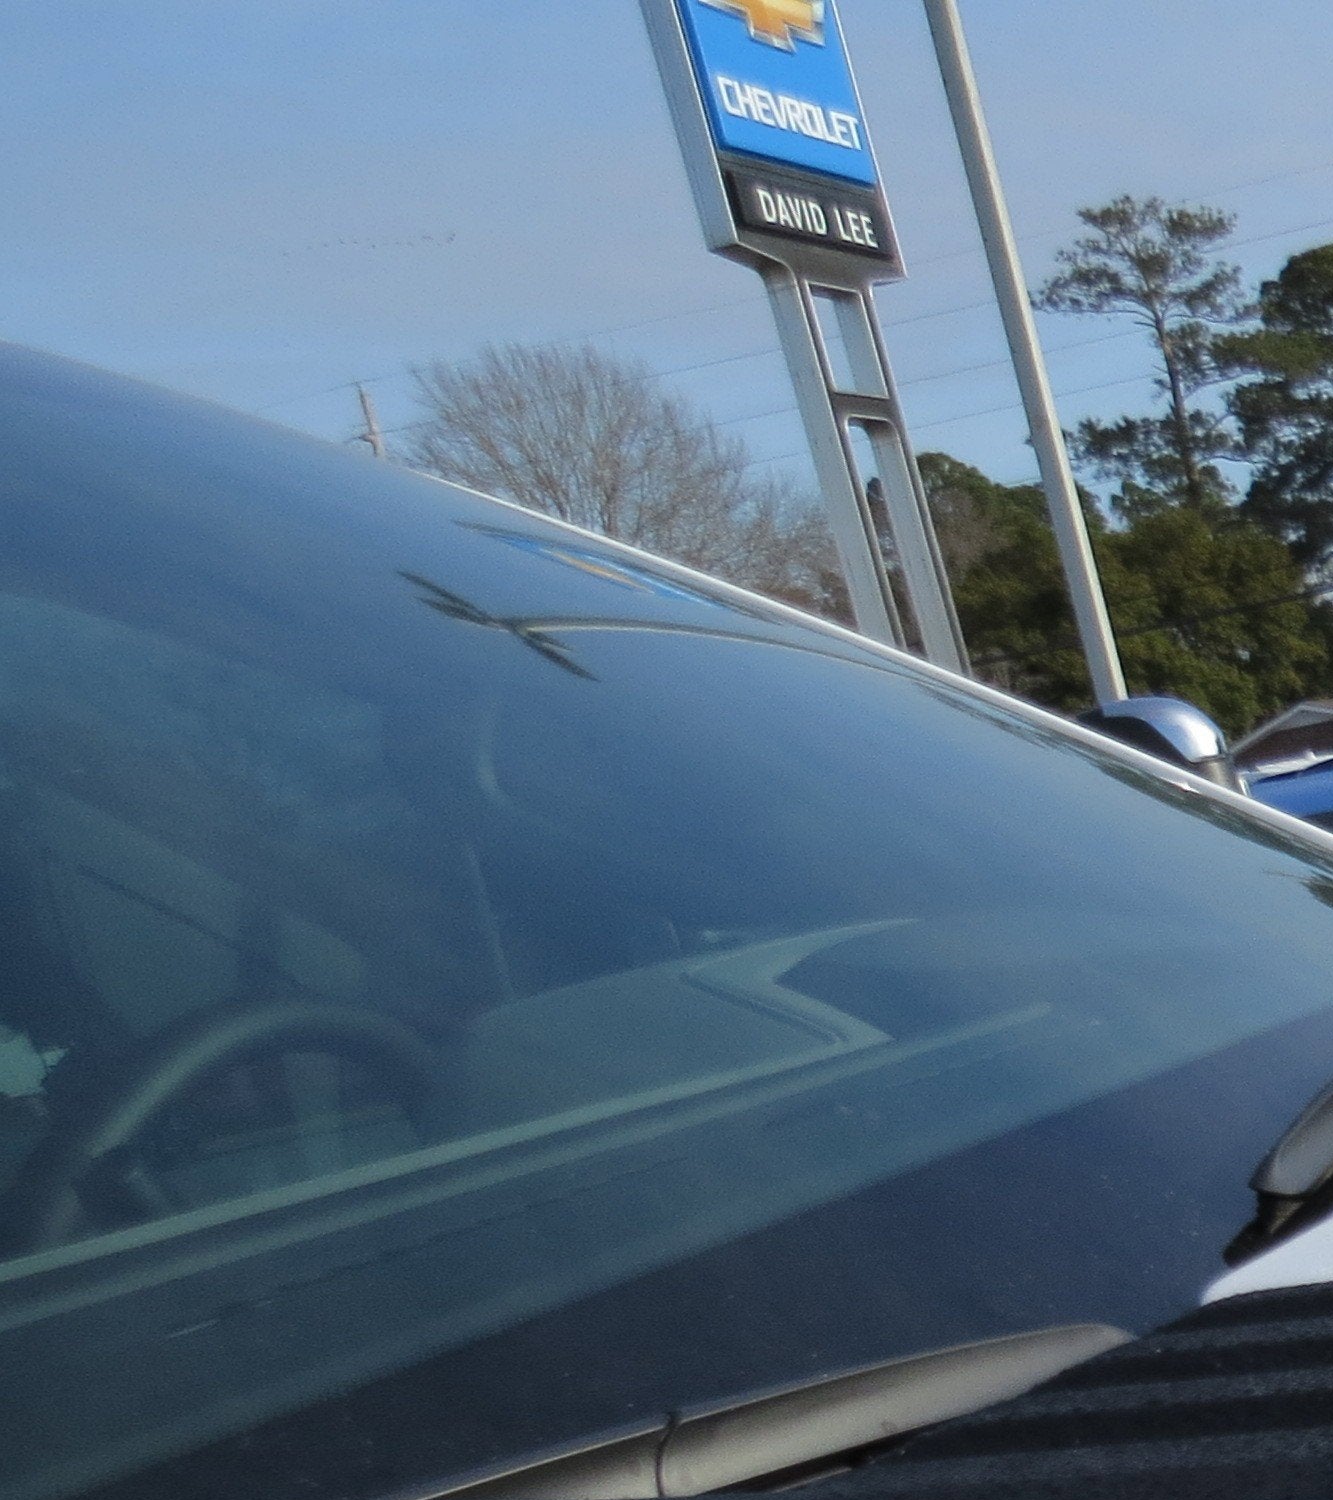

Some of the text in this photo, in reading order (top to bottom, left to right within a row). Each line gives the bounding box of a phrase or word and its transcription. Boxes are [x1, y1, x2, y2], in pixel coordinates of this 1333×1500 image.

[716, 75, 862, 151] CHEVROLET
[755, 187, 879, 249] DAVID LEE
